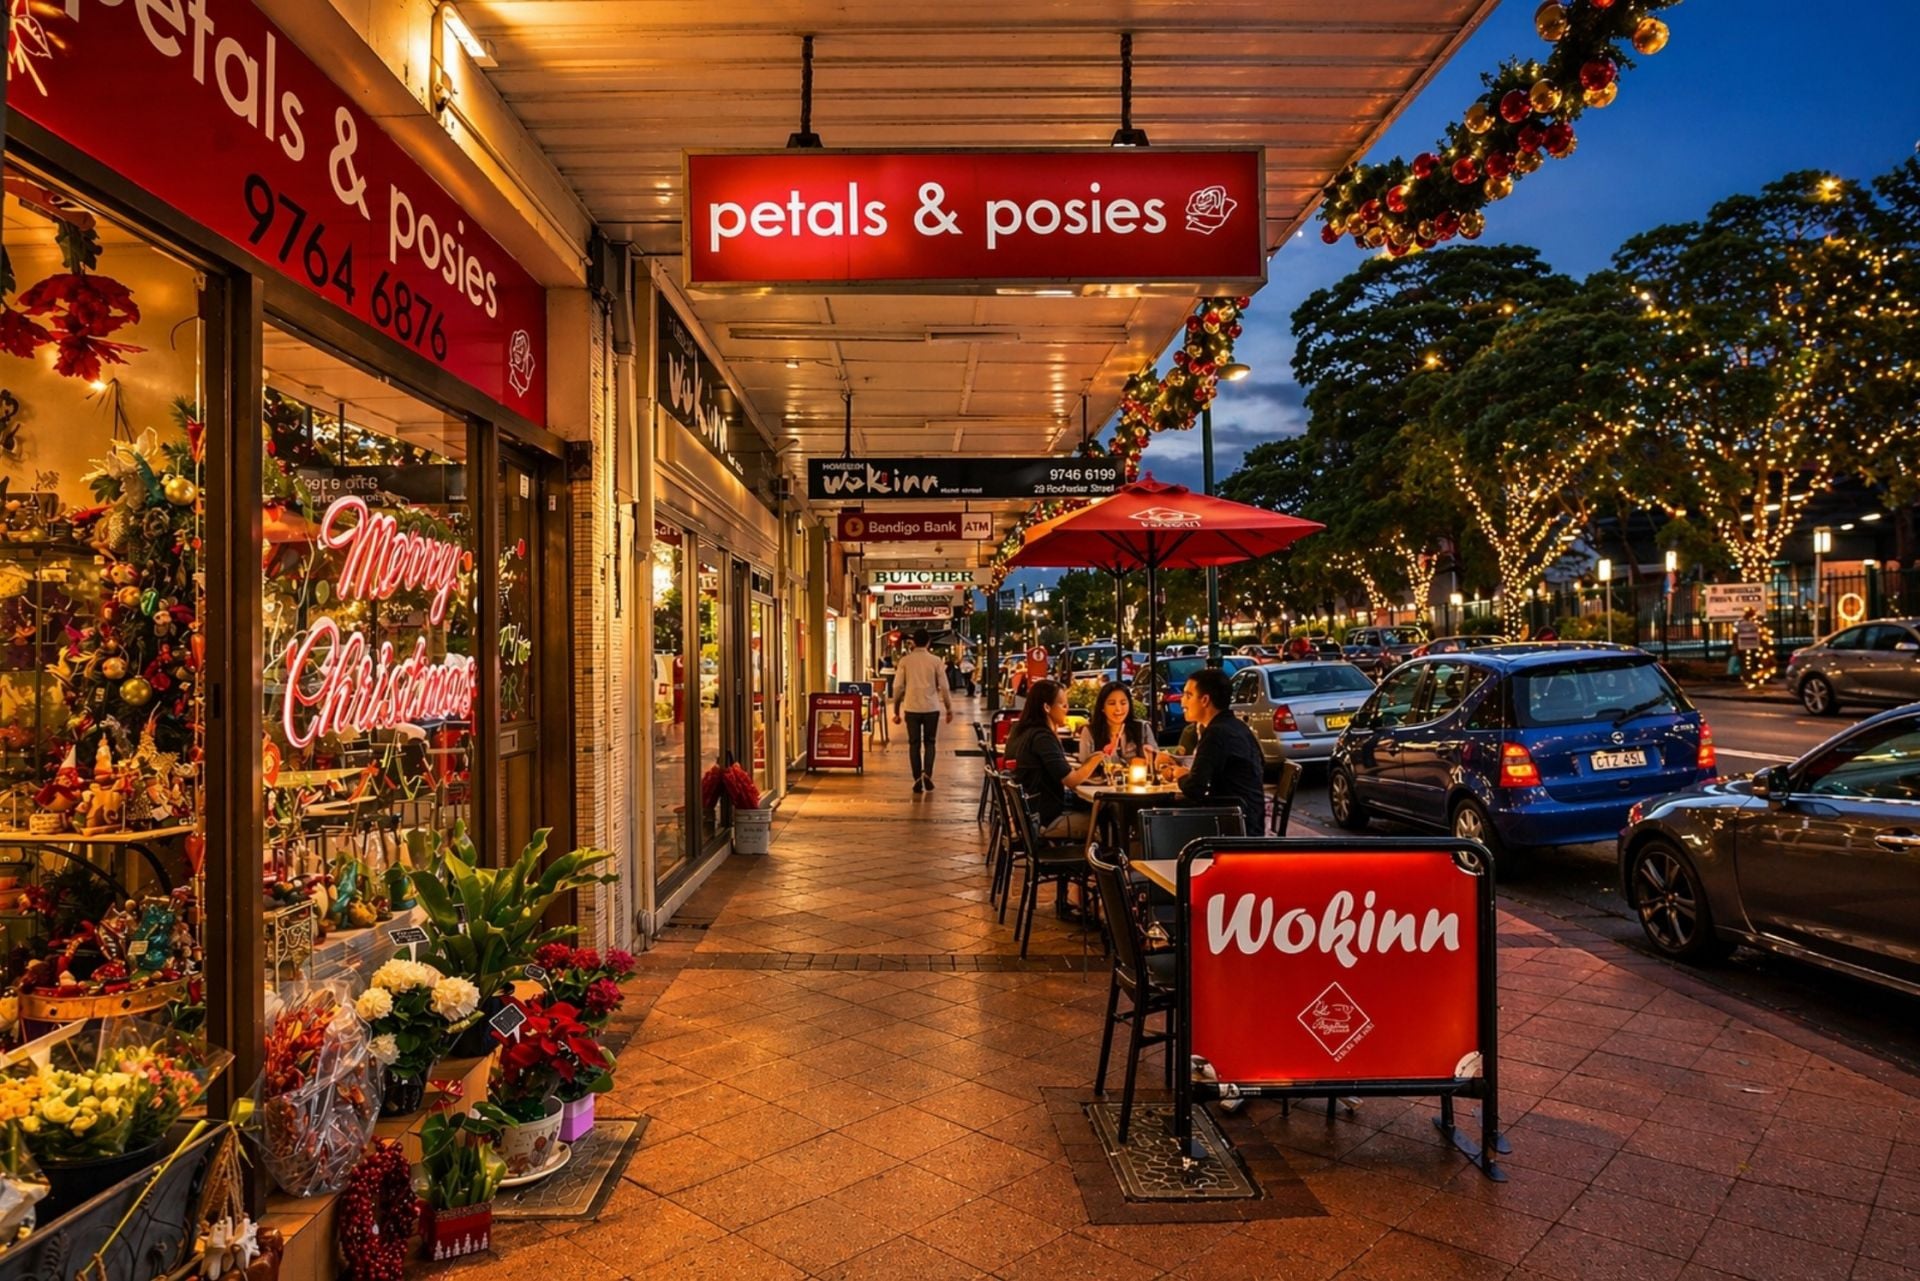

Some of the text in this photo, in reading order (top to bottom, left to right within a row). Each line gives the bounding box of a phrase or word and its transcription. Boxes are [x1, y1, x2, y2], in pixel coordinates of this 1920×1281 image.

[329, 106, 371, 222] &
[390, 183, 498, 318] posies
[710, 182, 1166, 252] petals & posies
[243, 172, 448, 362] 9764 6876
[1050, 469, 1116, 480] 9746 6199
[319, 494, 462, 625] Merry
[869, 520, 957, 536] Bendigo Bank
[964, 522, 990, 532] ATM
[875, 571, 974, 583] BUTCHER
[283, 616, 478, 748] Christmas
[1206, 890, 1461, 968] Wokinn
